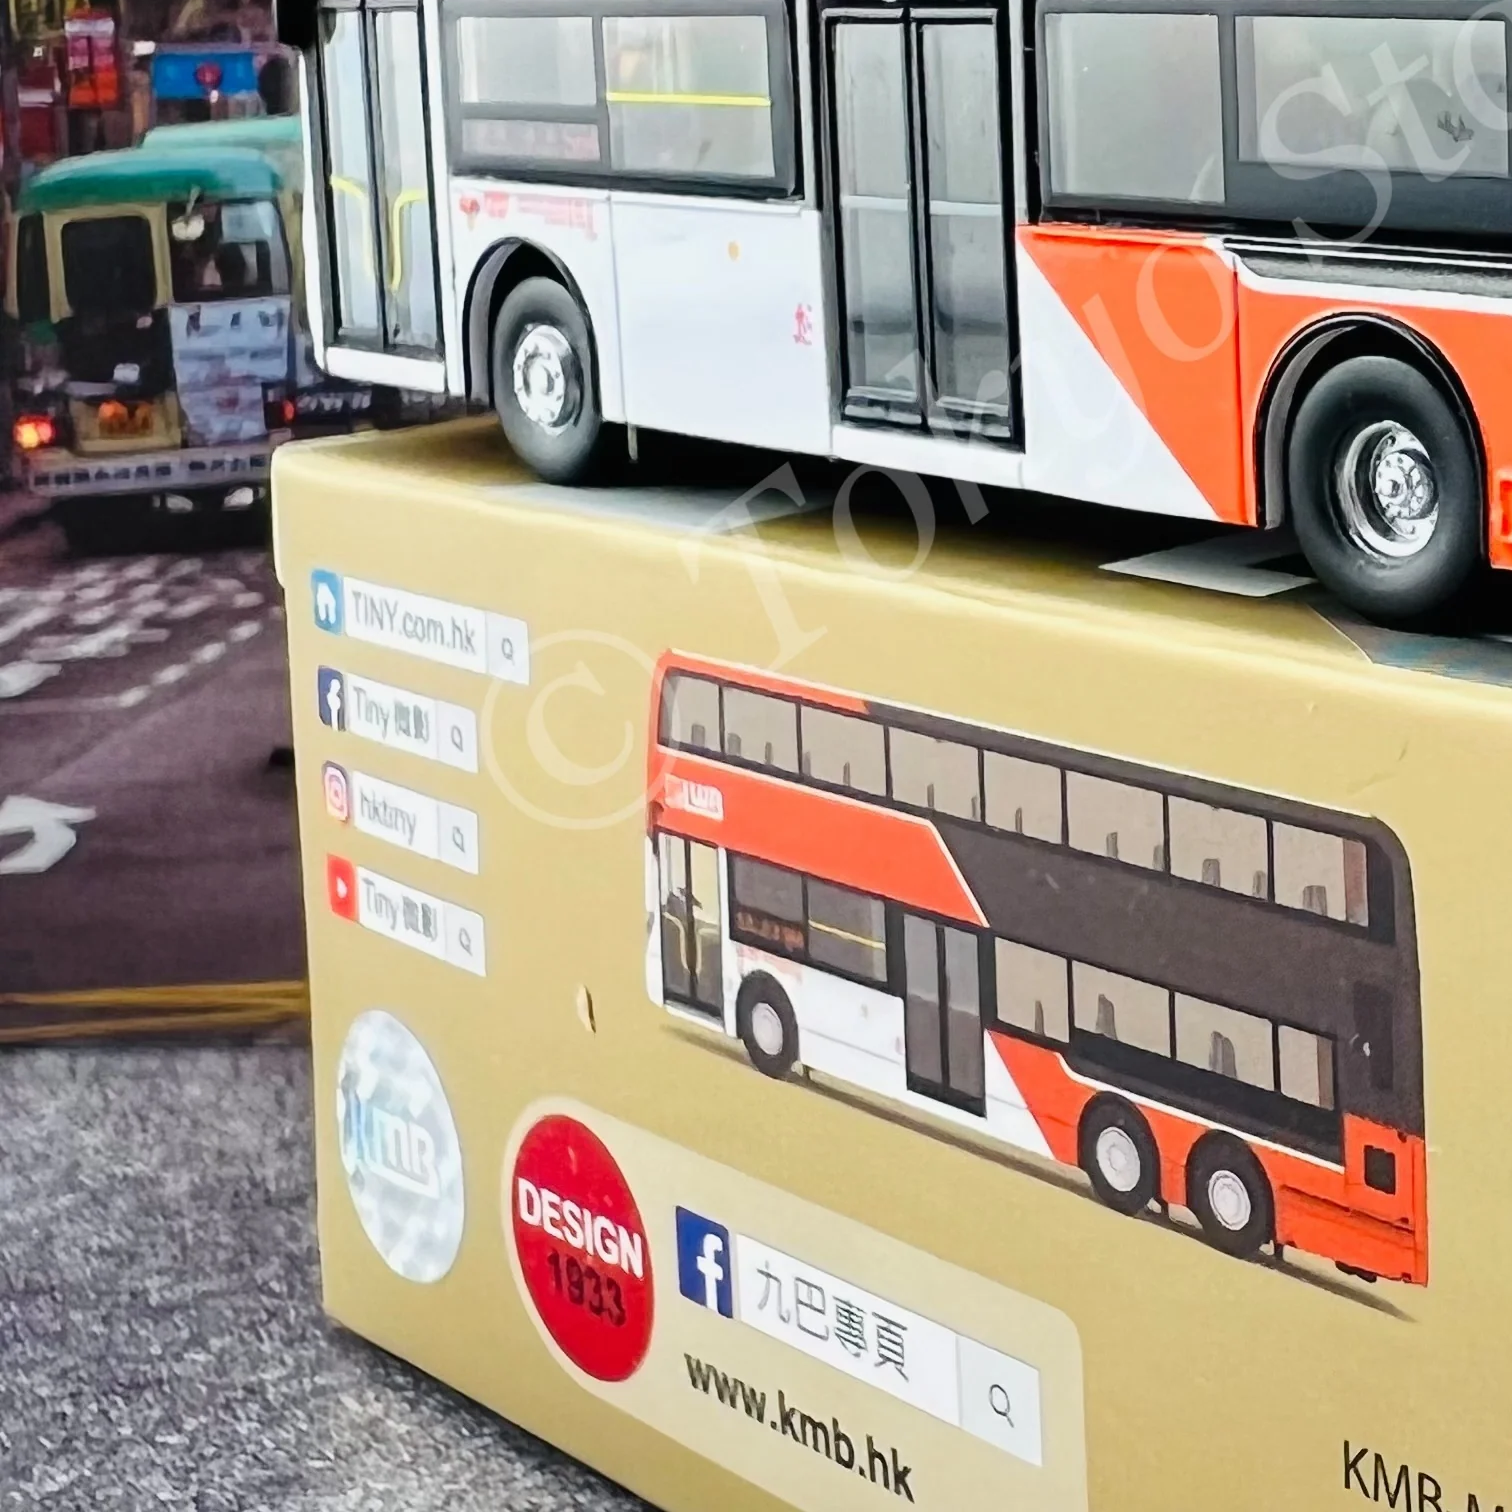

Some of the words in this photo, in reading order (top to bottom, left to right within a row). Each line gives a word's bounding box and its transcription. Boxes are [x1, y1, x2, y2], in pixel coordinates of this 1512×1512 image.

[352, 590, 477, 655] TINY.com.hk
[353, 685, 390, 739] Tiny
[517, 1176, 645, 1280] DESIGN
[756, 1259, 910, 1383] 九巴專頁
[683, 1352, 916, 1504] www.kmb.hk
